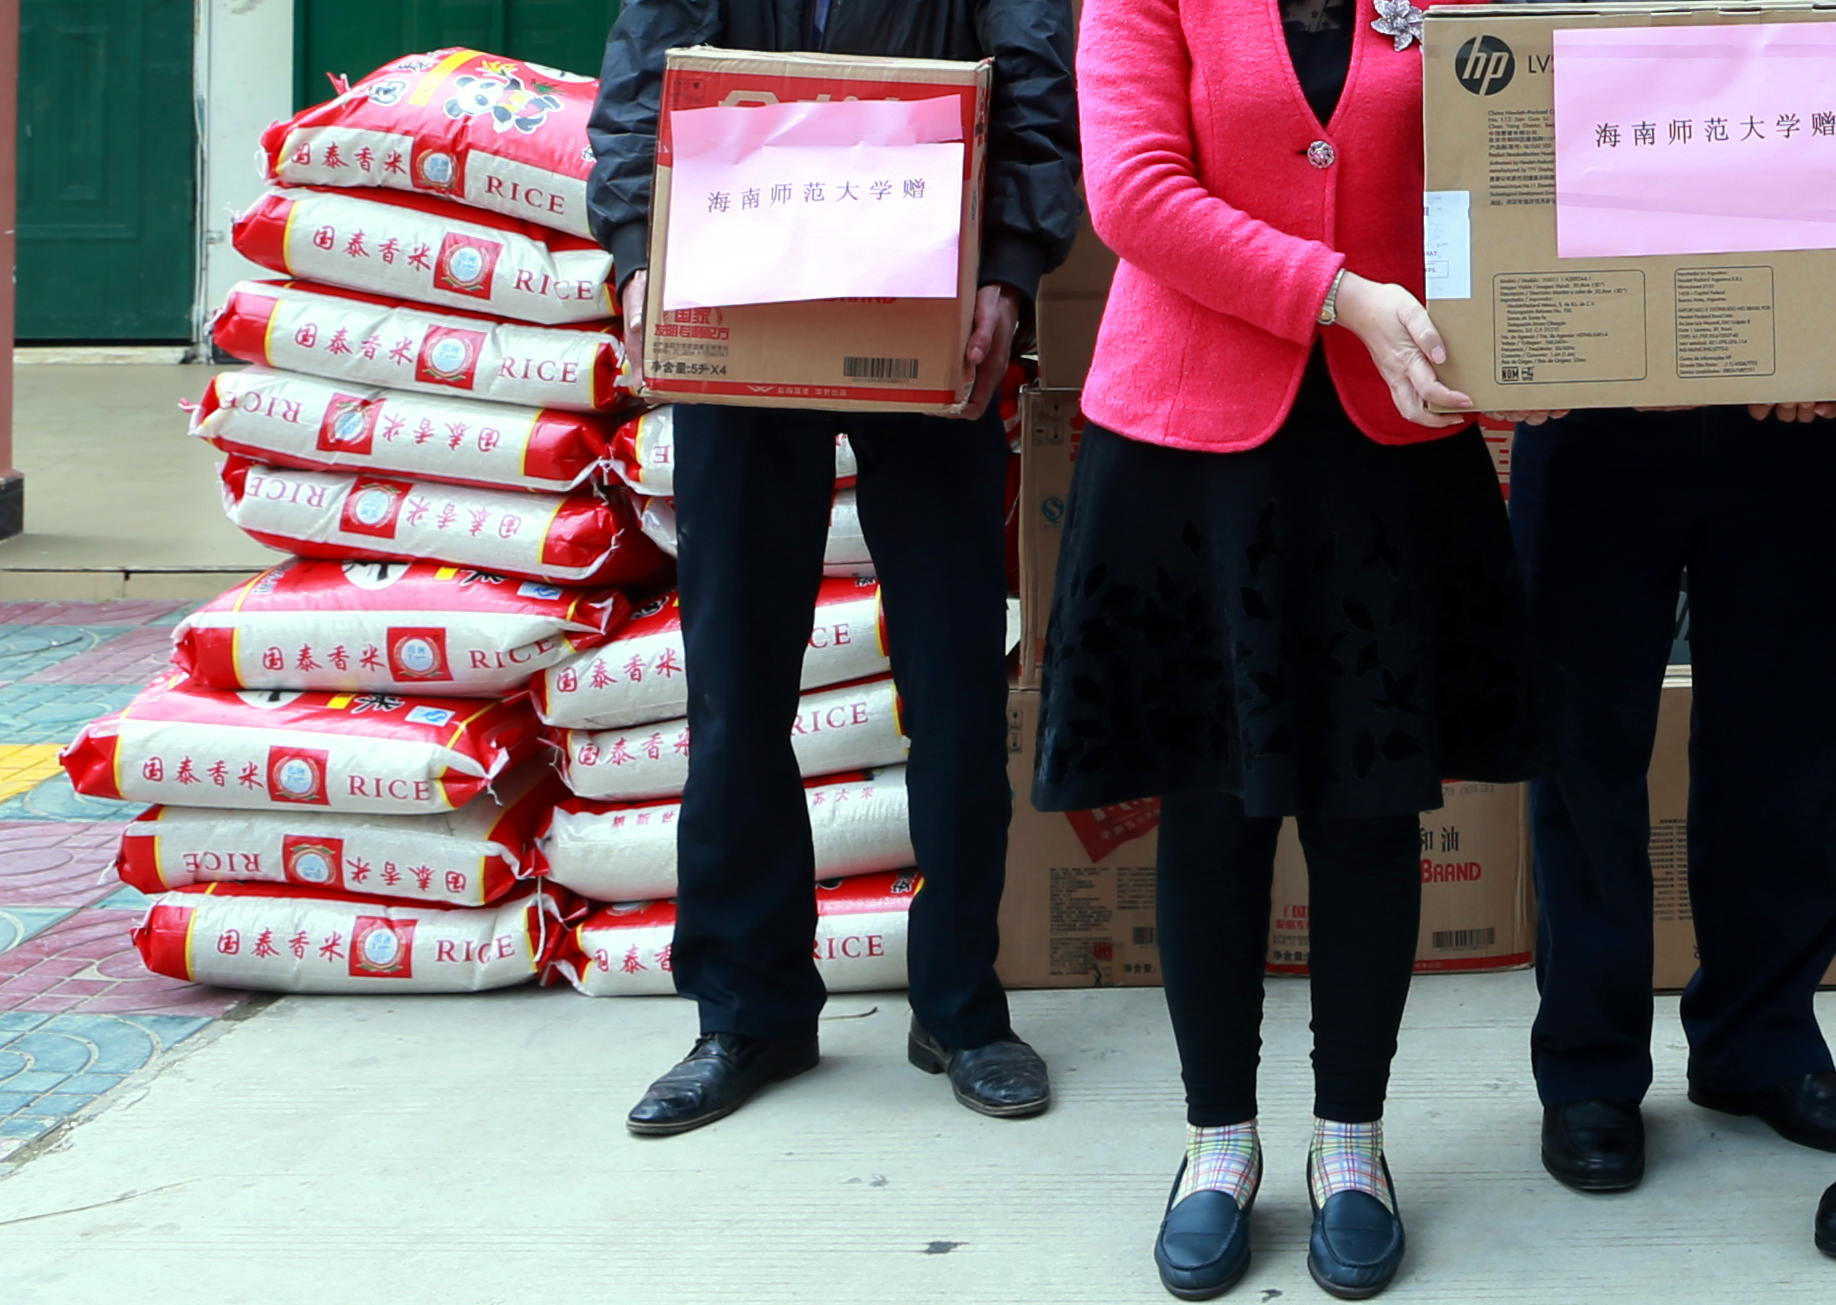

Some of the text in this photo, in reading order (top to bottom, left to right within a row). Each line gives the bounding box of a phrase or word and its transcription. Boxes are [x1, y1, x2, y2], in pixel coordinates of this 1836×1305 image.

[1455, 34, 1555, 96] hp LV
[1595, 110, 1836, 149] 海南师范大学赠
[292, 141, 407, 177] 国泰香米
[485, 174, 566, 215] RICE
[707, 177, 926, 214] 海南师范大学赠
[313, 225, 432, 272] 国泰香米
[514, 268, 595, 301] RICE
[295, 322, 415, 366] 国泰香米
[498, 355, 579, 384] RICE
[219, 391, 303, 424] RICE
[383, 412, 500, 453] 国泰香米
[246, 475, 328, 508] RICE
[407, 495, 522, 539] 国泰香米
[810, 622, 853, 649] CE
[262, 642, 387, 673] 国泰香米
[469, 637, 556, 670] RICE
[556, 648, 682, 694] 国泰香米
[791, 702, 869, 736] RICE
[142, 756, 264, 790] 国泰香米
[349, 775, 431, 801] RICE
[183, 852, 261, 873] RICE
[345, 856, 467, 893] 国泰香米
[1421, 859, 1482, 883] BRAND
[217, 928, 345, 963] 国泰香米
[436, 934, 516, 963] RICE
[593, 949, 672, 975] 国泰香
